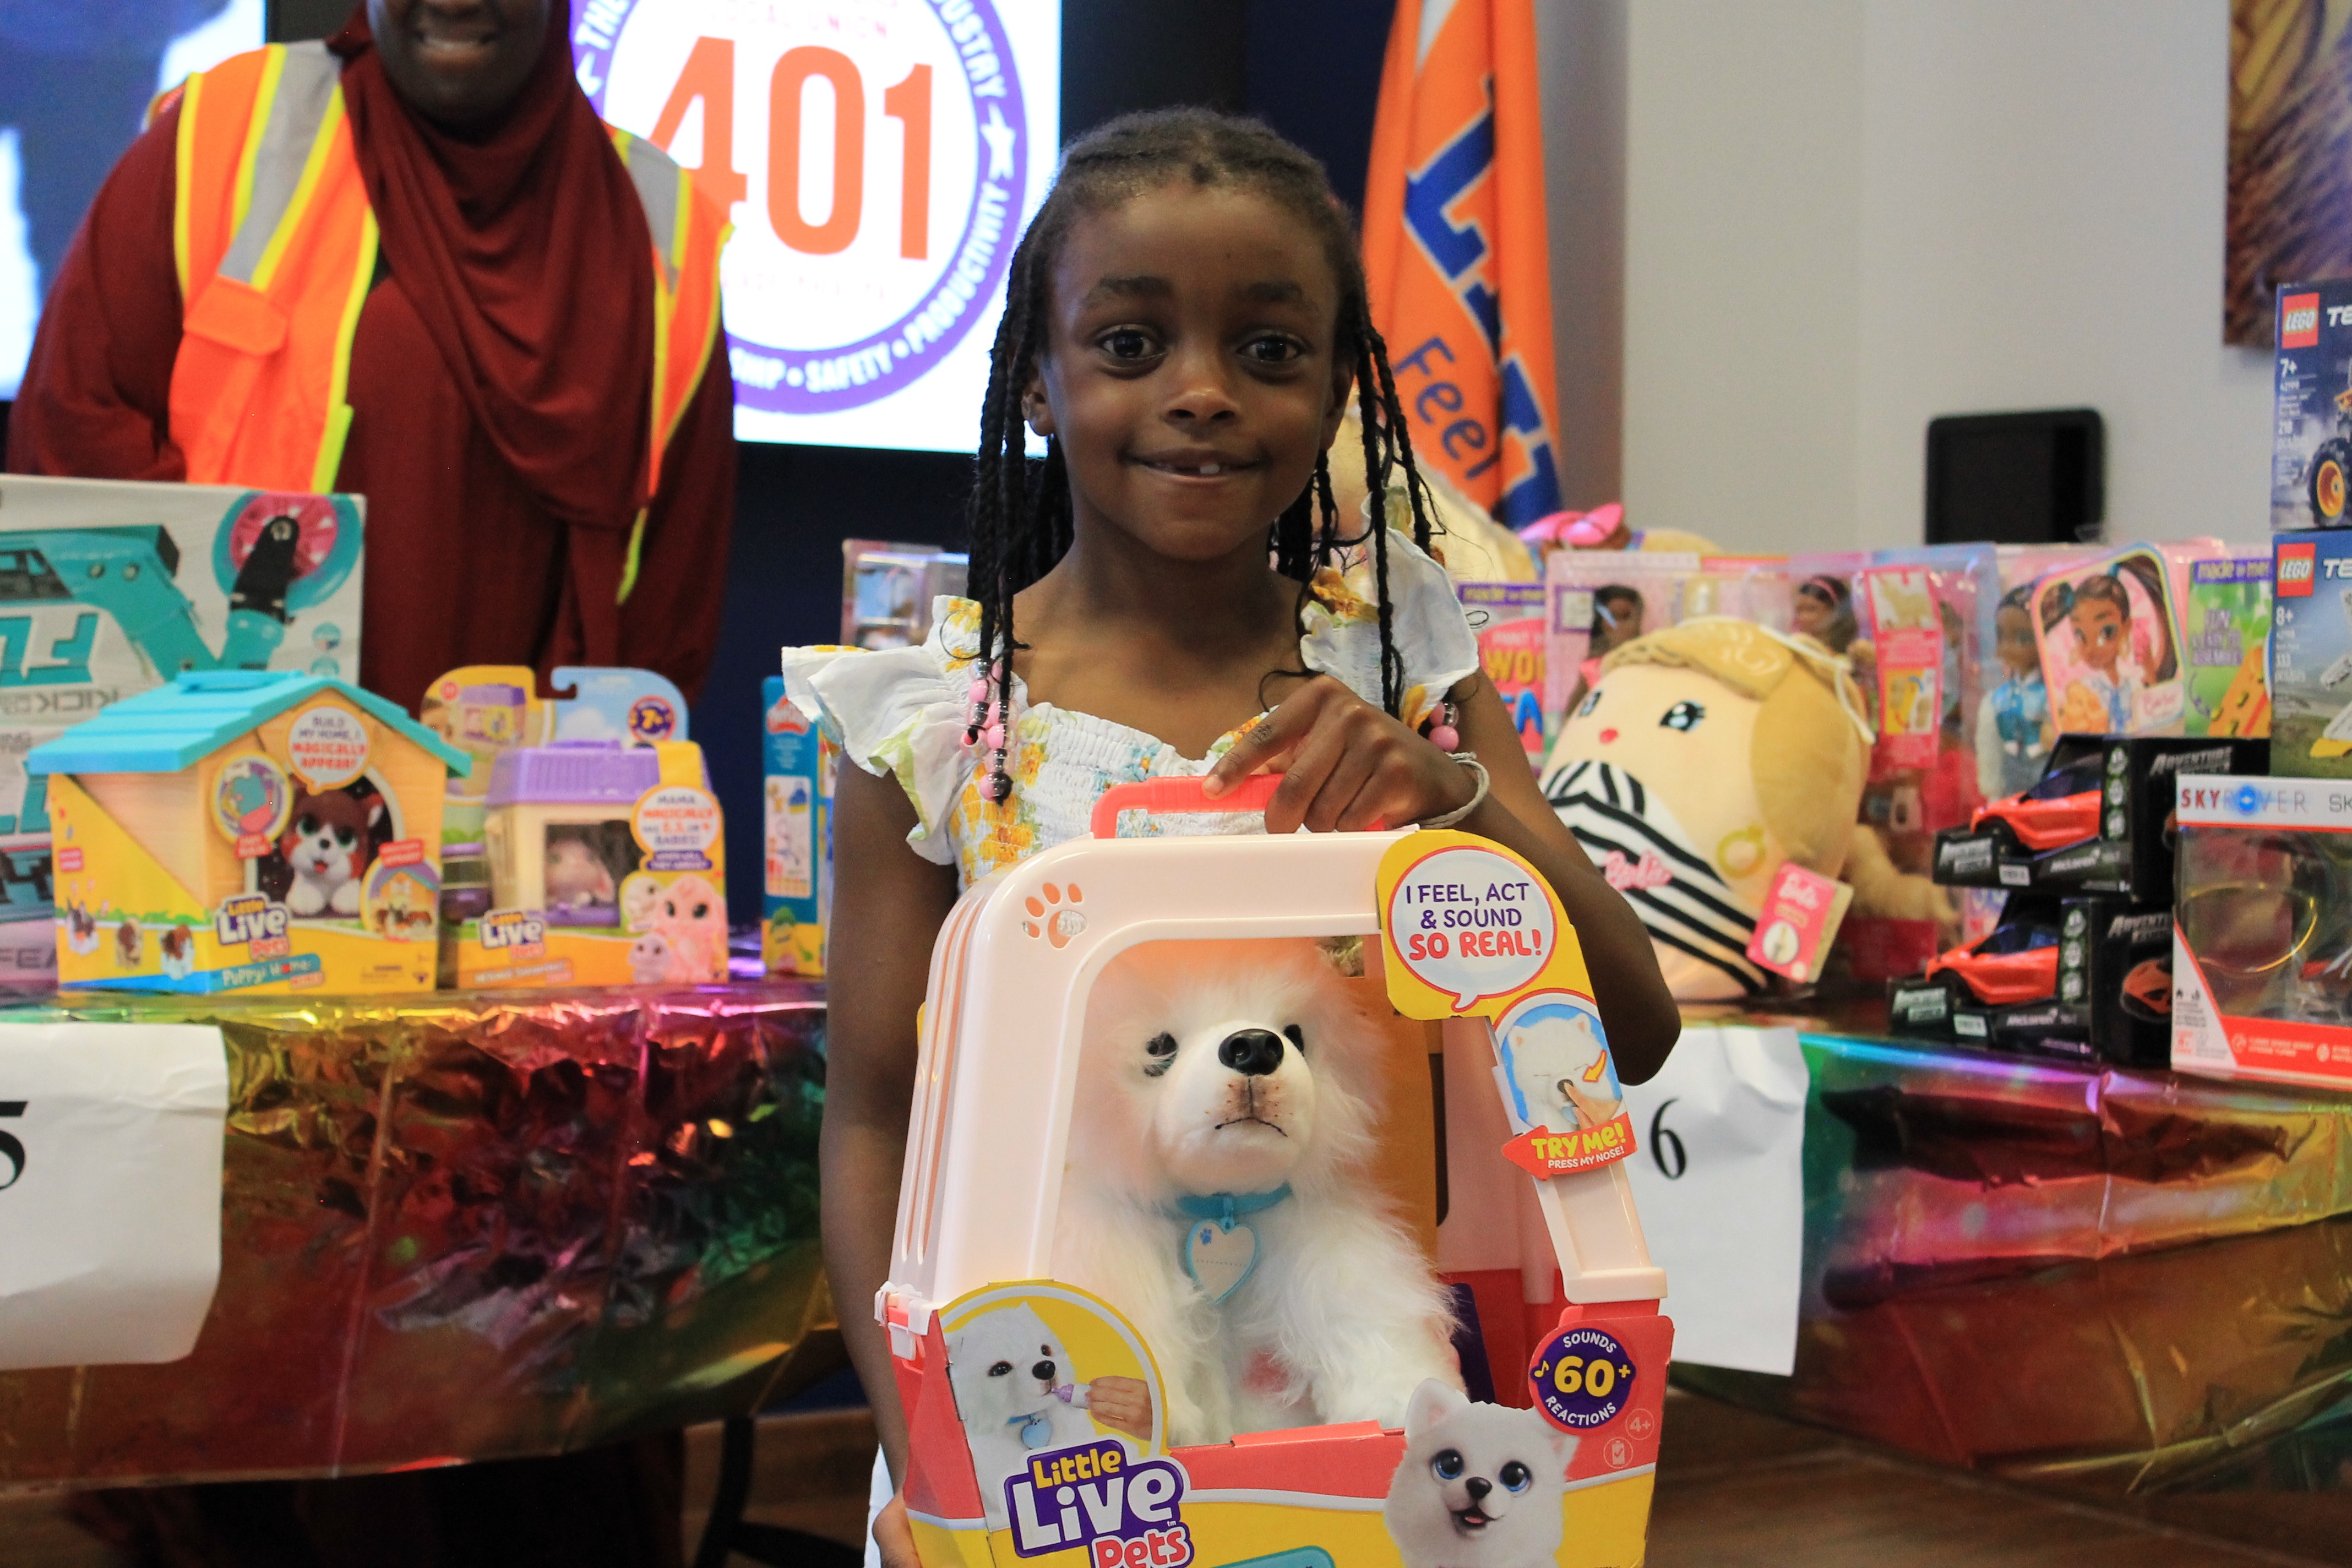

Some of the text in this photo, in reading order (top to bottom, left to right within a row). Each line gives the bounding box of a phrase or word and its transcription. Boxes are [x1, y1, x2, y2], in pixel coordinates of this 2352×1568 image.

[933, 0, 1007, 98] USTRY
[647, 35, 933, 260] 401
[805, 340, 893, 394] SAFETY
[903, 180, 1010, 355] PRODUCTIVITY
[2284, 311, 2317, 332] LEGO
[1393, 336, 1502, 481] Feel
[2279, 560, 2311, 580] LEGO
[2276, 606, 2294, 626] 8+
[1406, 883, 1529, 905] I FEEL, ACT
[218, 909, 287, 944] Live
[1420, 907, 1522, 929] & SOUND
[481, 921, 543, 947] Live
[1408, 929, 1542, 961] SO REAL!
[1531, 1136, 1579, 1159] TRY
[1649, 1098, 1687, 1181] 6
[1547, 1146, 1625, 1169] PRESS MY NOSE!
[1562, 1331, 1617, 1353] SOUNDS
[1553, 1355, 1631, 1397] 60+
[1545, 1395, 1616, 1426] REACTIONS
[1629, 1417, 1651, 1432] 4+
[1032, 1448, 1122, 1489] Little
[1012, 1468, 1177, 1551] Live
